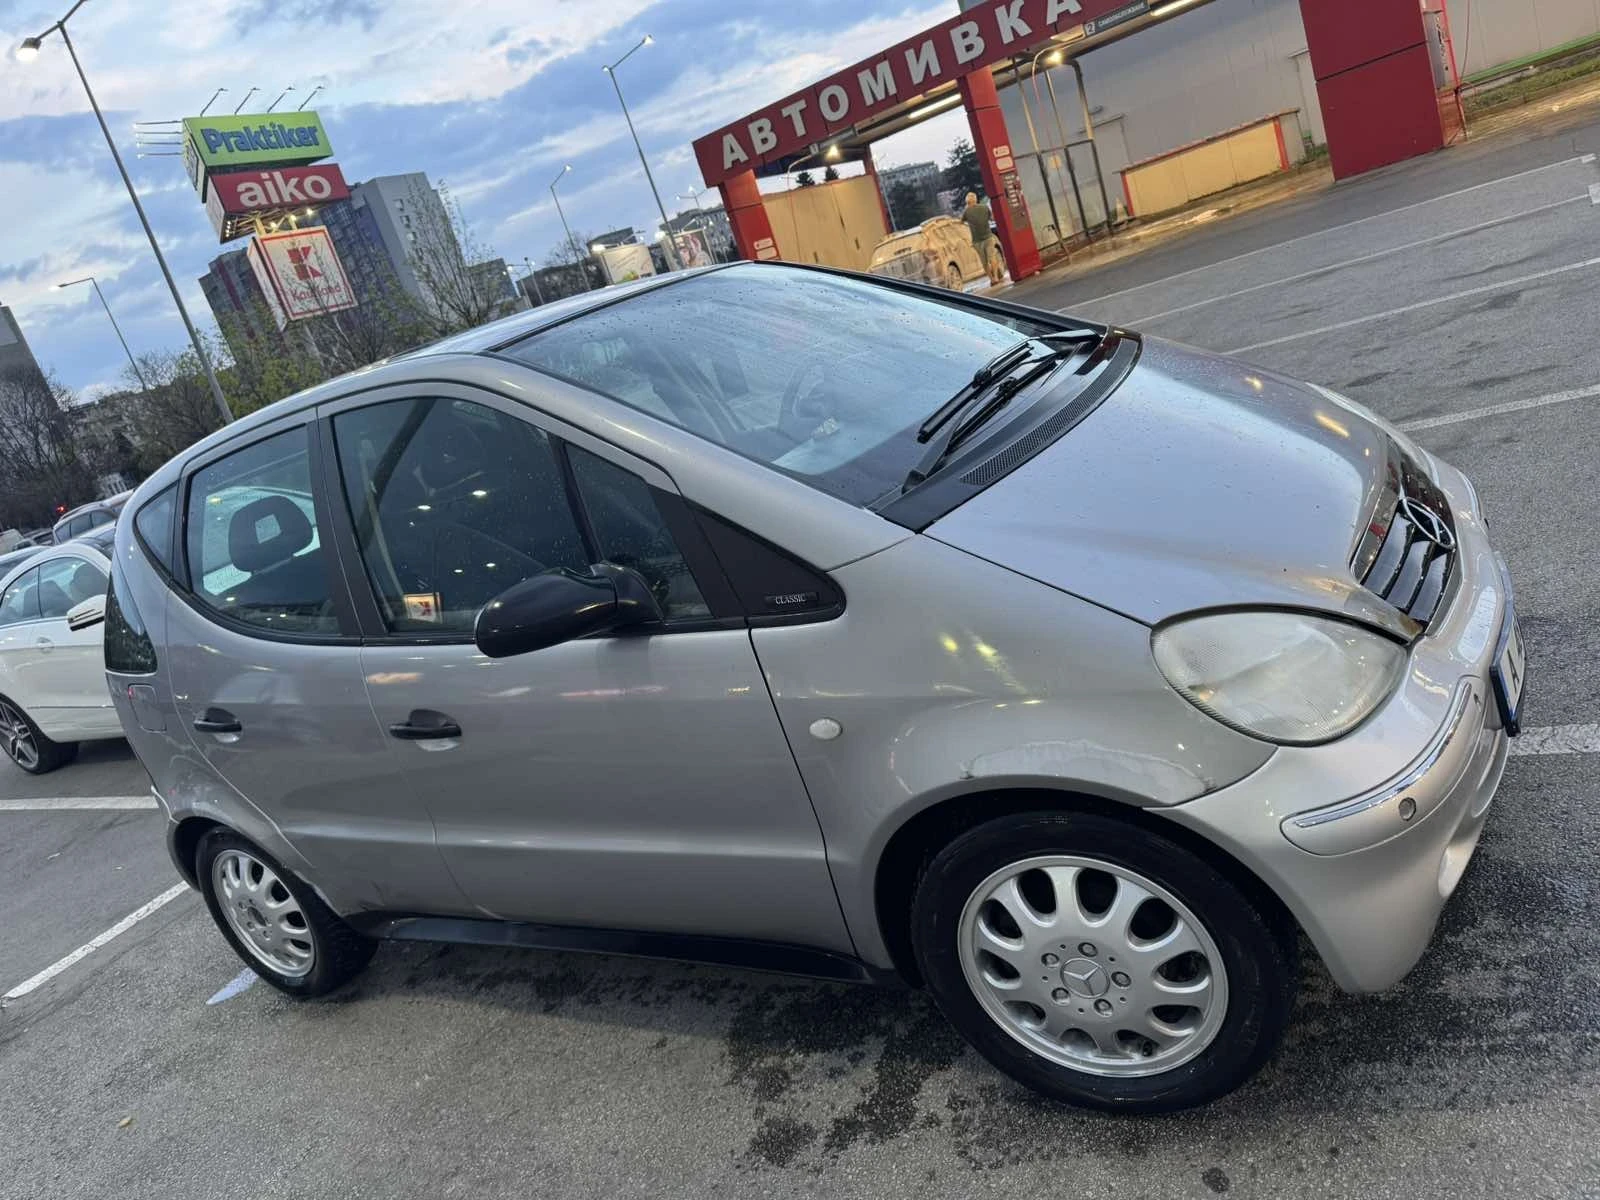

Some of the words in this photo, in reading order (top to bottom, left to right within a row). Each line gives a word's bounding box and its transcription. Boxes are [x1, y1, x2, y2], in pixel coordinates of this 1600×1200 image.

[722, 0, 1082, 170] АВТОМИВКА
[200, 121, 319, 154] Praktiker
[236, 171, 332, 208] aiko
[775, 593, 807, 605] CLASSIC
